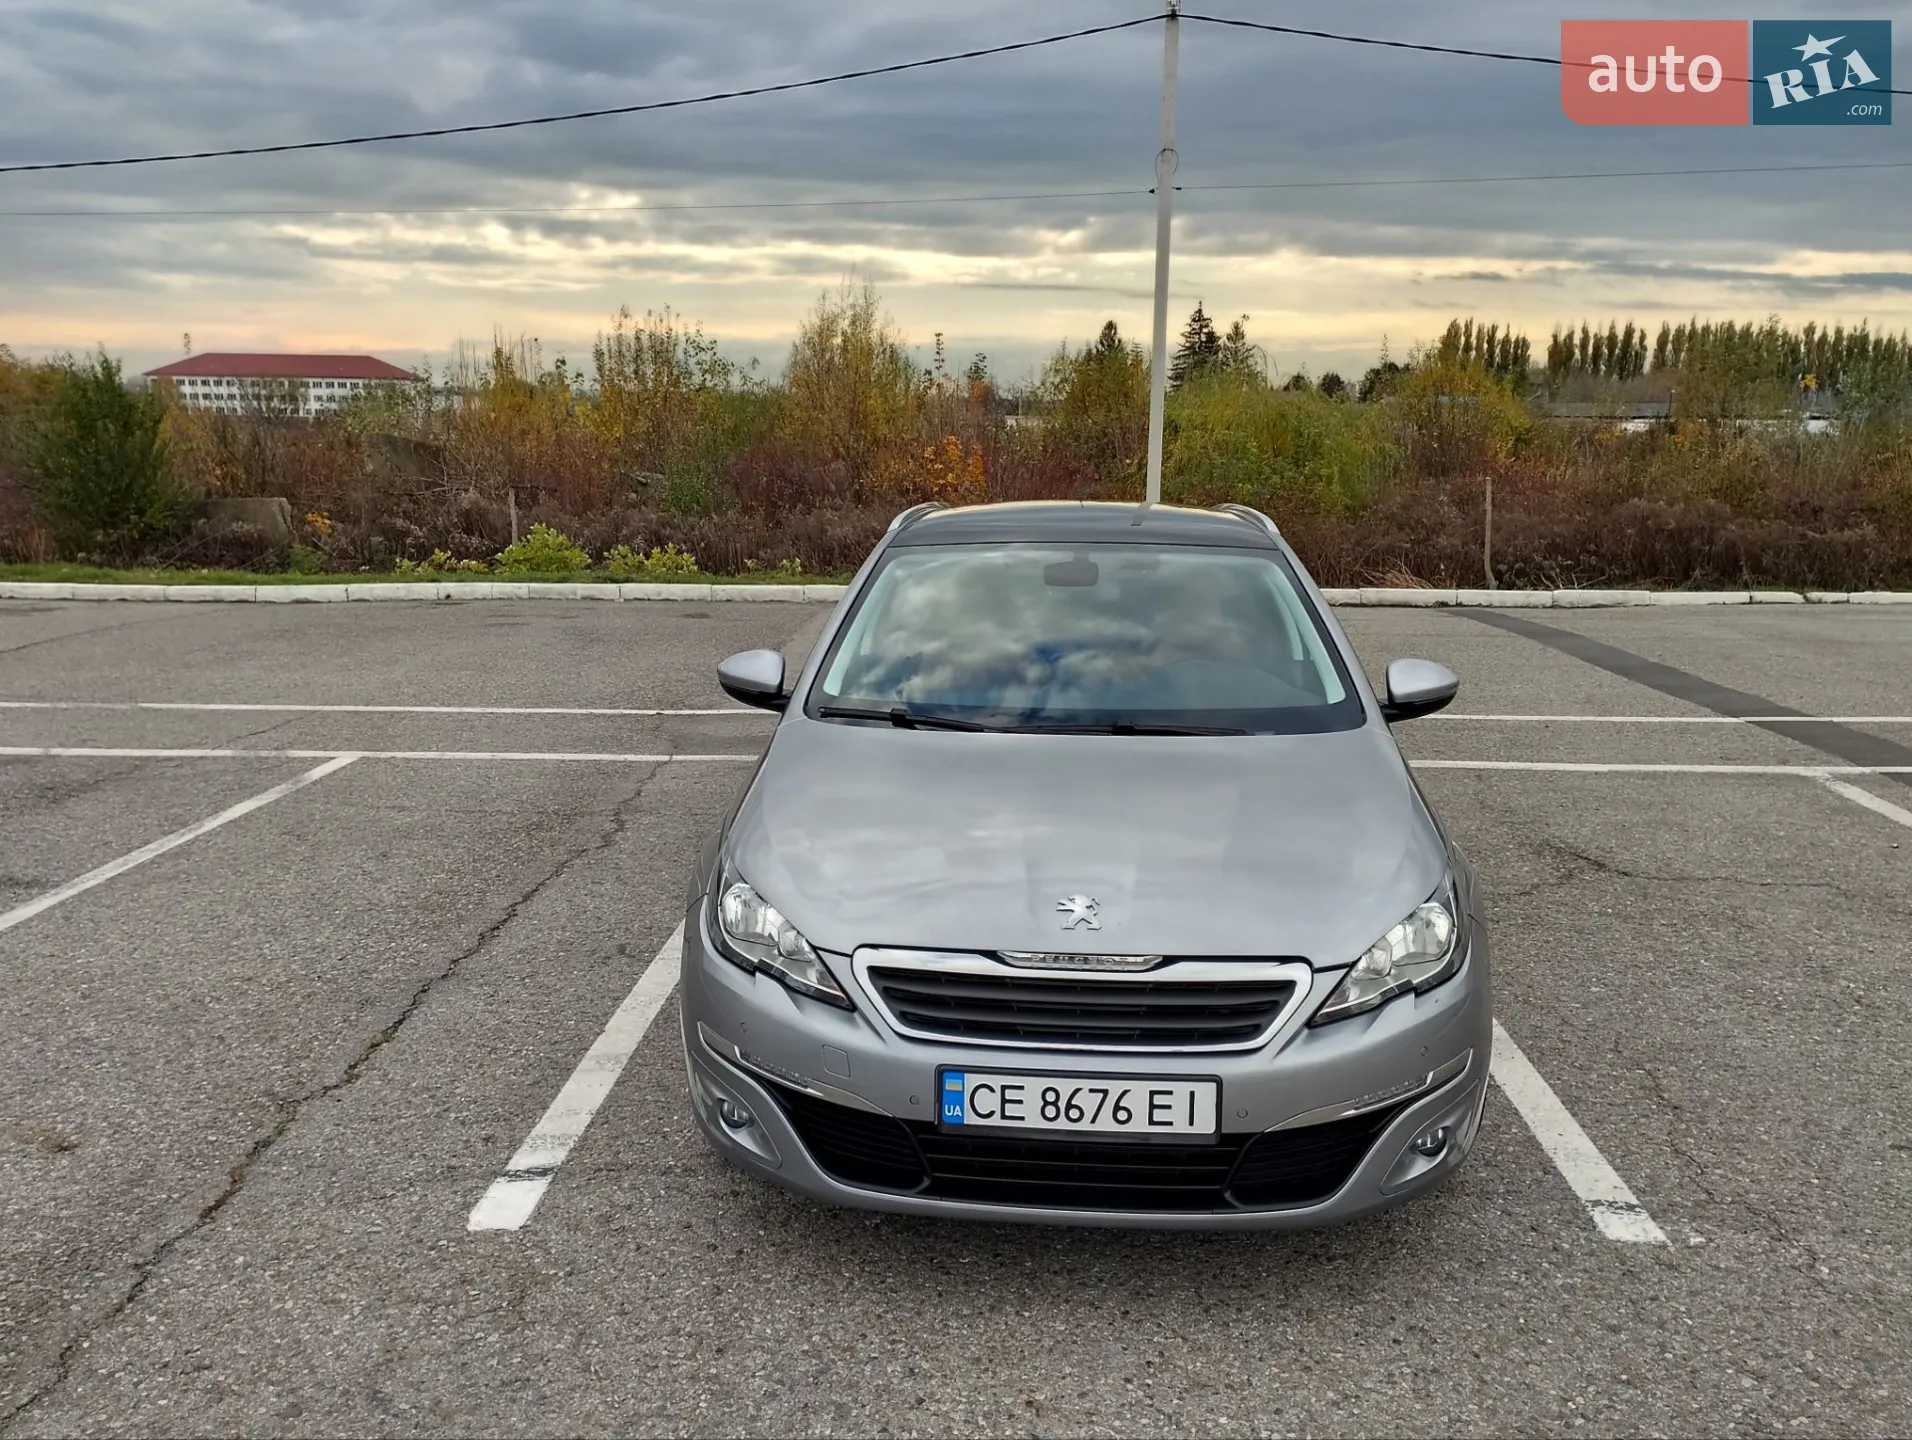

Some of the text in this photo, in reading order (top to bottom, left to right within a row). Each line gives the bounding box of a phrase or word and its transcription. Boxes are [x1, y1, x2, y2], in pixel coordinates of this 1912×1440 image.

[945, 1104, 962, 1117] UA
[969, 1083, 1196, 1127] CE 8676 EI
